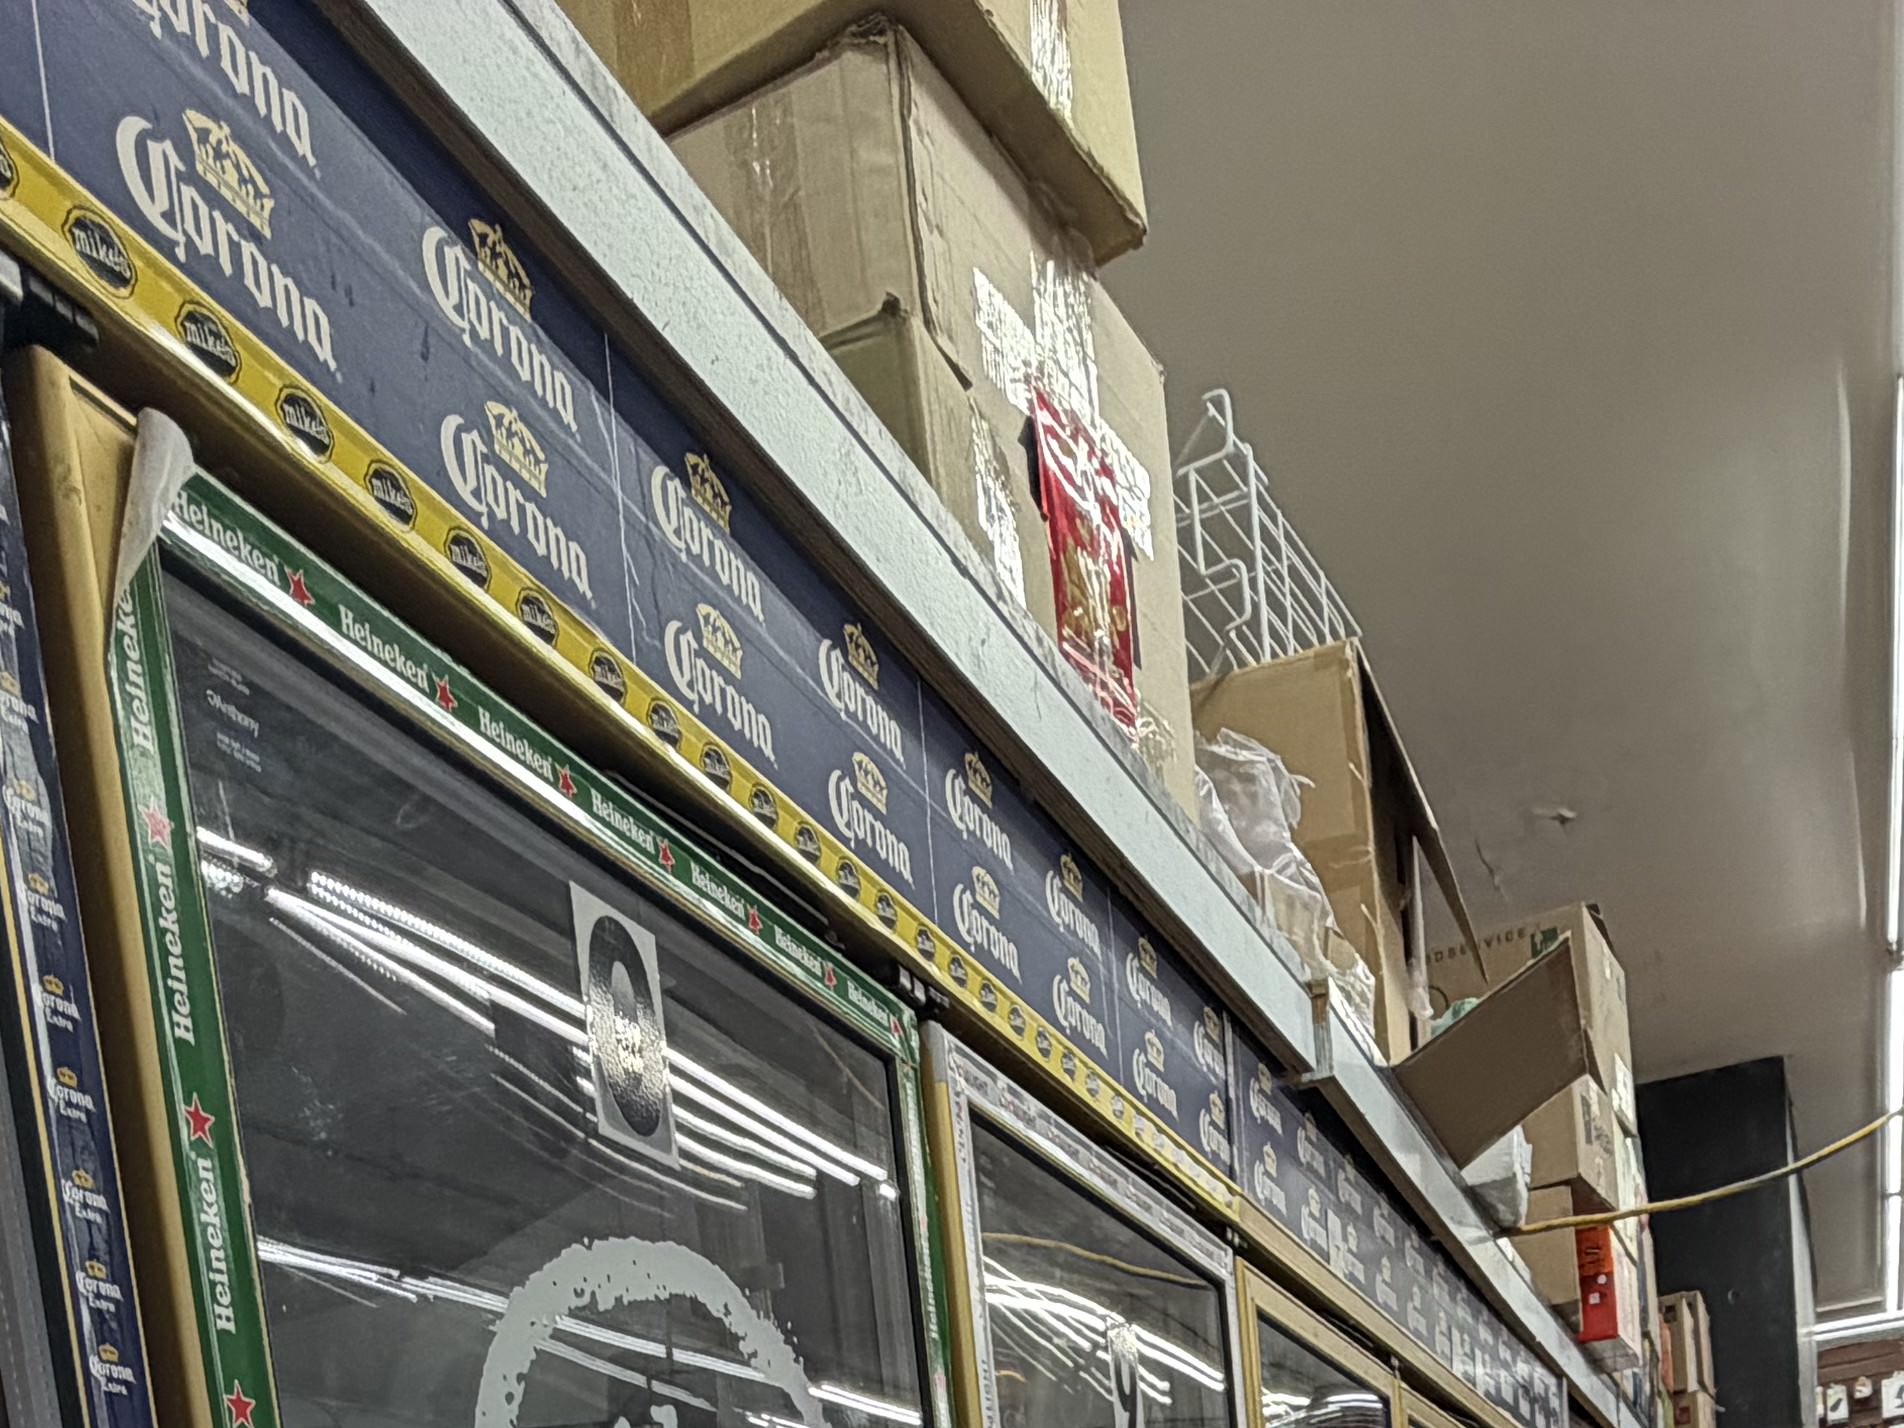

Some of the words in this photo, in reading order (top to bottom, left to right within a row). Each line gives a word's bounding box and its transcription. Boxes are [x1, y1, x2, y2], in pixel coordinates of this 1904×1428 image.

[116, 116, 343, 383] Corona
[423, 226, 582, 441] Corona
[174, 490, 282, 584] Heineken
[441, 415, 596, 607] Corona
[651, 465, 766, 623] Corona
[114, 585, 156, 756] Heineke
[818, 638, 907, 770] Corona
[477, 709, 556, 781] Heineken
[945, 767, 1015, 875] Corona
[689, 861, 746, 916] Heineken
[1045, 867, 1103, 955] Corona
[155, 858, 198, 1045] Heineken
[1052, 972, 1108, 1059] Corona
[48, 1078, 95, 1112] Corona
